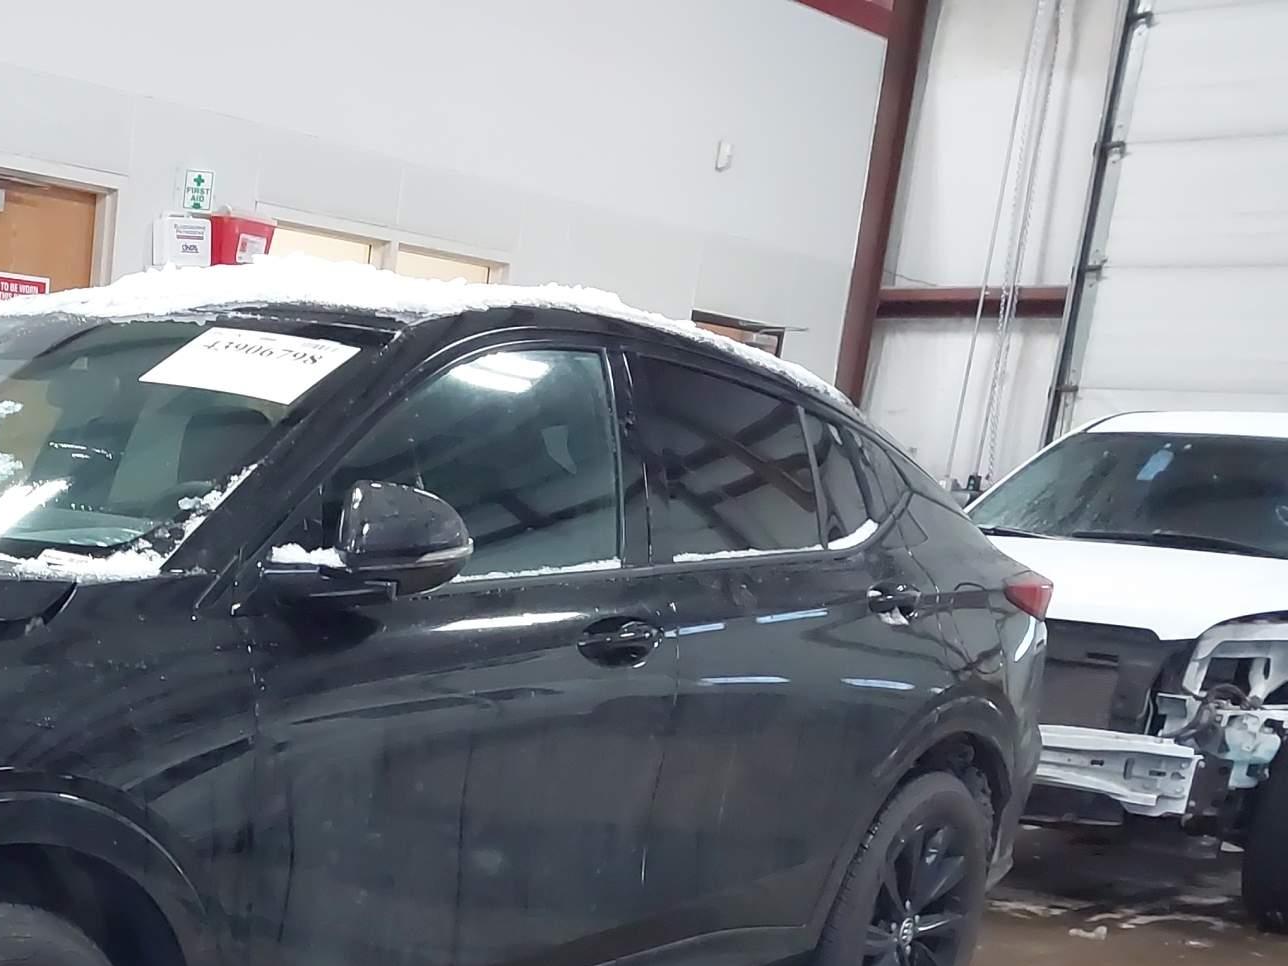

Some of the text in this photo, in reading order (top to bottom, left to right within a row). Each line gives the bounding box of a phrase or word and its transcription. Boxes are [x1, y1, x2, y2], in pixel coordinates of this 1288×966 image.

[186, 187, 209, 195] FIRST
[191, 194, 204, 202] AID
[0, 281, 9, 292] TO
[9, 283, 19, 293] BE
[19, 284, 39, 295] WORN
